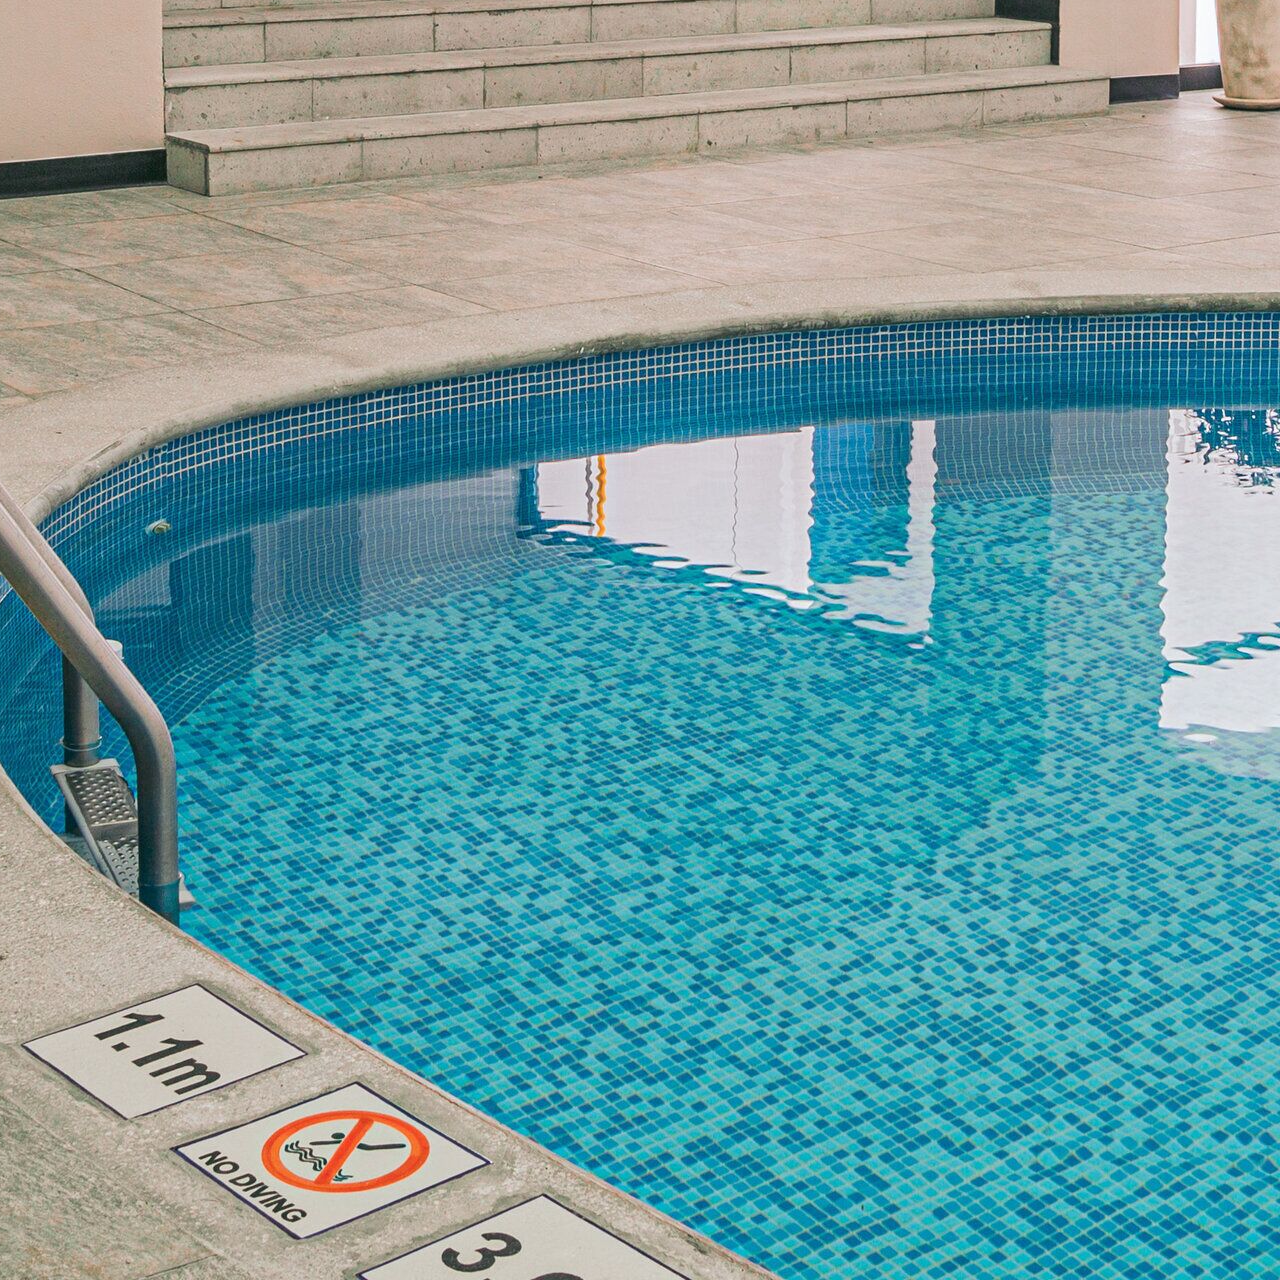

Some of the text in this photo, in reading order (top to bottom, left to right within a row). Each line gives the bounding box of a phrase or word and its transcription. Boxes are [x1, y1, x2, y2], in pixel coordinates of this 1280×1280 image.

[94, 1012, 221, 1095] 1.1m
[198, 1150, 307, 1222] NO DIVING
